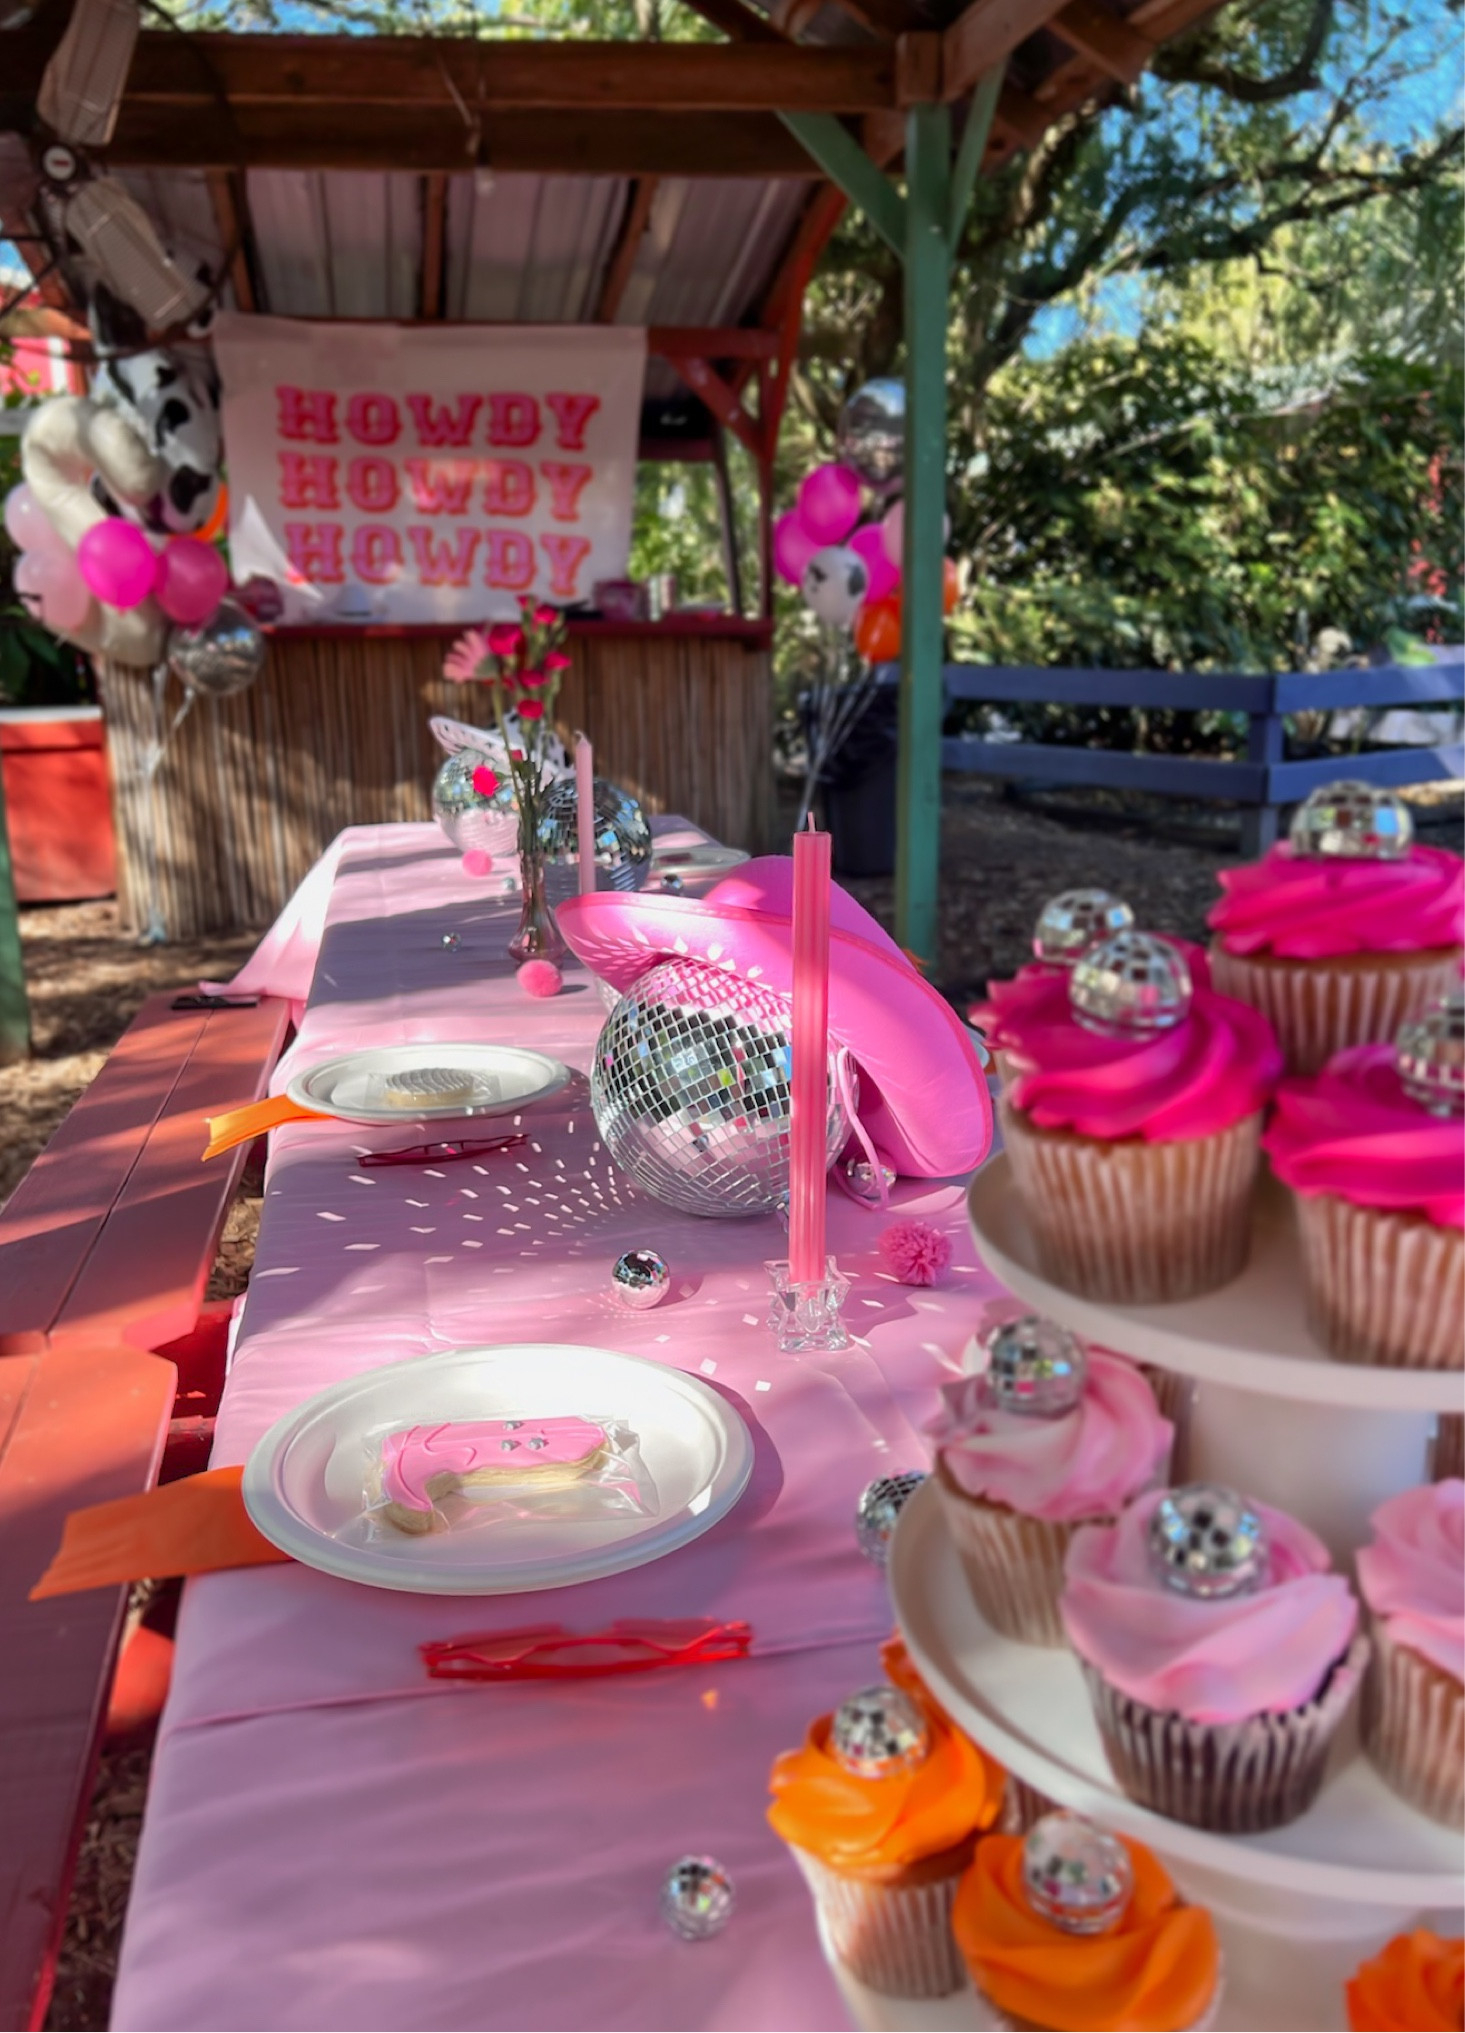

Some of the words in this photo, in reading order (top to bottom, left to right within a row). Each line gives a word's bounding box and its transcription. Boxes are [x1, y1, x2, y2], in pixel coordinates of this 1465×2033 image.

[277, 385, 600, 451] HOWDY
[280, 453, 593, 521] HOWDY
[285, 524, 592, 597] HOWDY
